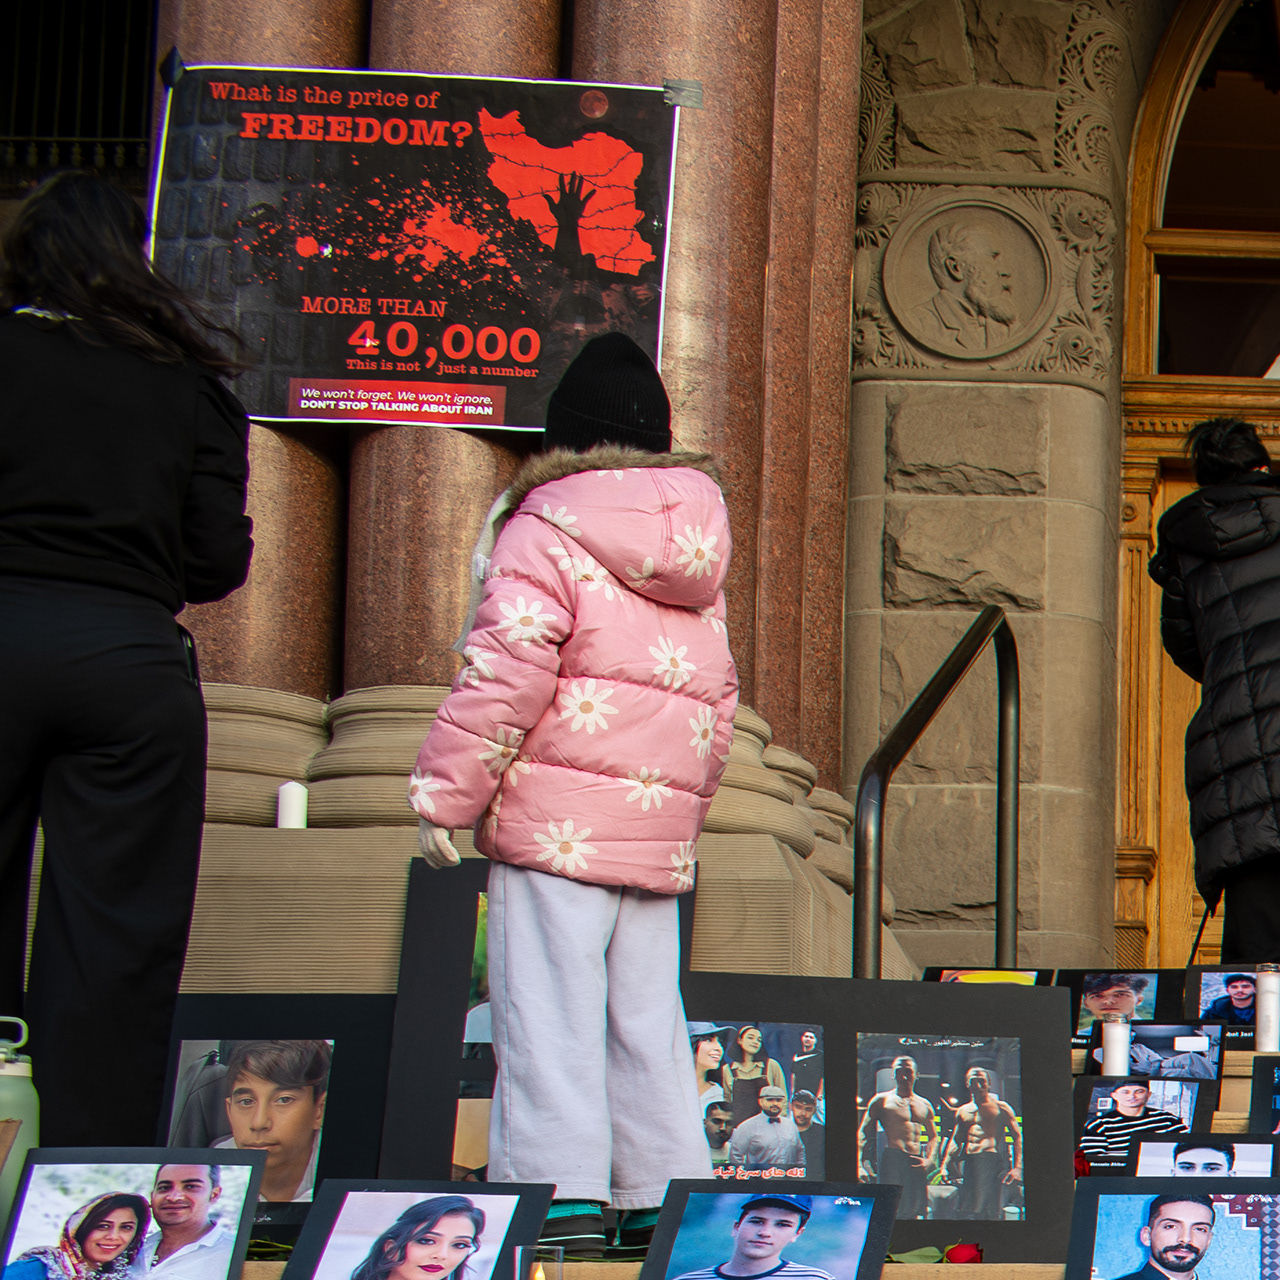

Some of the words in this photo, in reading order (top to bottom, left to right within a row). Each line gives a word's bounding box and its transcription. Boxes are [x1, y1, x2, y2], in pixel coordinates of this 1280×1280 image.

[209, 82, 272, 101] What
[277, 85, 297, 102] is
[303, 86, 342, 104] the
[348, 89, 408, 108] price
[415, 92, 440, 108] of
[240, 113, 473, 147] FREEDOM?
[301, 296, 371, 314] MORE
[378, 299, 448, 317] THAN
[348, 321, 540, 369] 40,000
[346, 359, 377, 370] This
[380, 360, 393, 370] is
[396, 361, 420, 371] not
[437, 362, 466, 376] just
[469, 366, 478, 375] a
[481, 366, 539, 377] number
[301, 388, 321, 398] We
[323, 389, 354, 399] won't
[357, 390, 394, 401] forget.
[398, 391, 416, 400] We
[418, 392, 451, 402] won't
[454, 394, 493, 405] ignore.
[300, 400, 336, 409] DON'T
[338, 401, 369, 411] STOP
[372, 402, 419, 412] TALKING
[422, 404, 462, 414] ABOUT
[464, 406, 493, 415] IRAN
